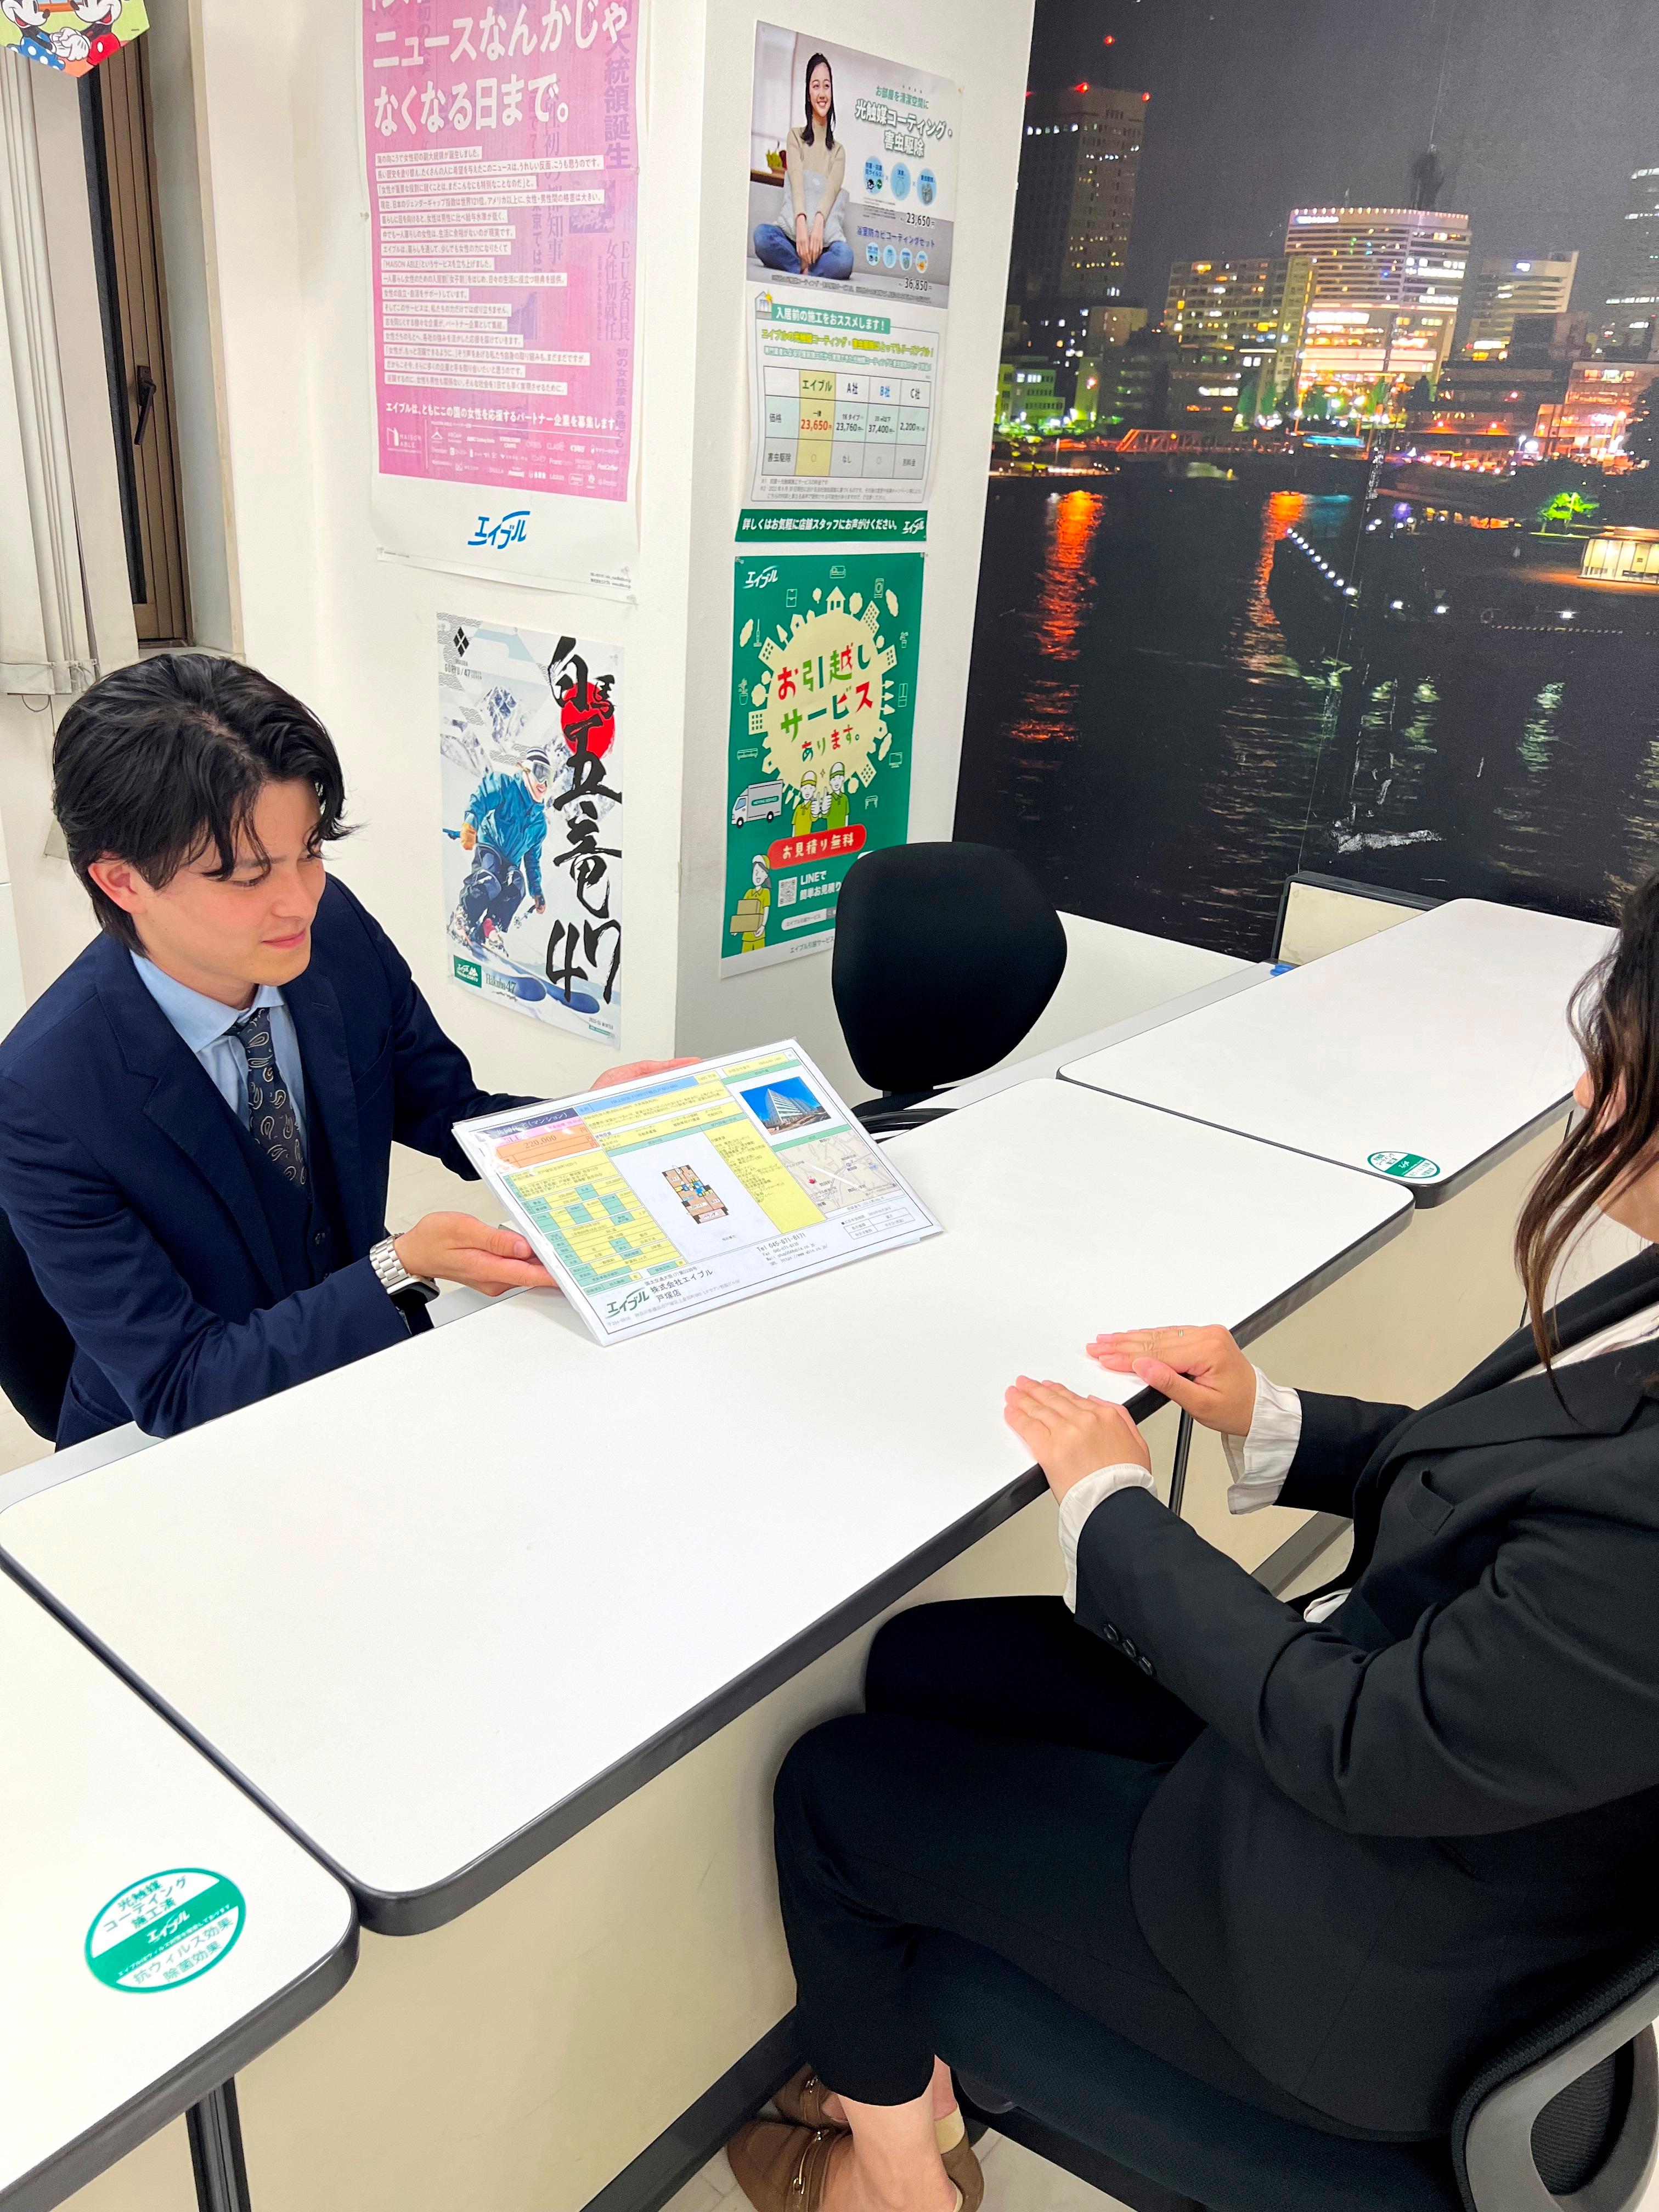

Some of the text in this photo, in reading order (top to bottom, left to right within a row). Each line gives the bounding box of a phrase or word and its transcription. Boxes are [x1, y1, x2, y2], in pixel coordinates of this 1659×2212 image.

[373, 0, 628, 68] ニュースなんかじゃ
[374, 73, 568, 136] なくなる日まで。
[884, 129, 925, 159] 害虫駆除
[802, 380, 833, 392] エイブル
[386, 403, 619, 430] エイブルは、ともにこの国の女性を応援するパートナー企業を募集します。
[467, 511, 531, 549] エイブル
[902, 517, 925, 534] エイブル
[743, 565, 779, 589] エイブル
[777, 642, 871, 701] お引越し
[780, 681, 873, 743] サービス
[801, 724, 860, 763] あります。
[782, 832, 854, 860] お見積り無料
[800, 870, 827, 885] LINEで
[650, 1269, 713, 1293] 株式会社エイブル
[656, 1289, 681, 1302] 戸塚店
[605, 1287, 650, 1319] エイブル
[102, 1875, 188, 1933] コーティング
[145, 1910, 190, 1944] エイブル
[132, 1916, 233, 1984] 抗ウィルス効果
[162, 1940, 222, 1983] 除菌効果
